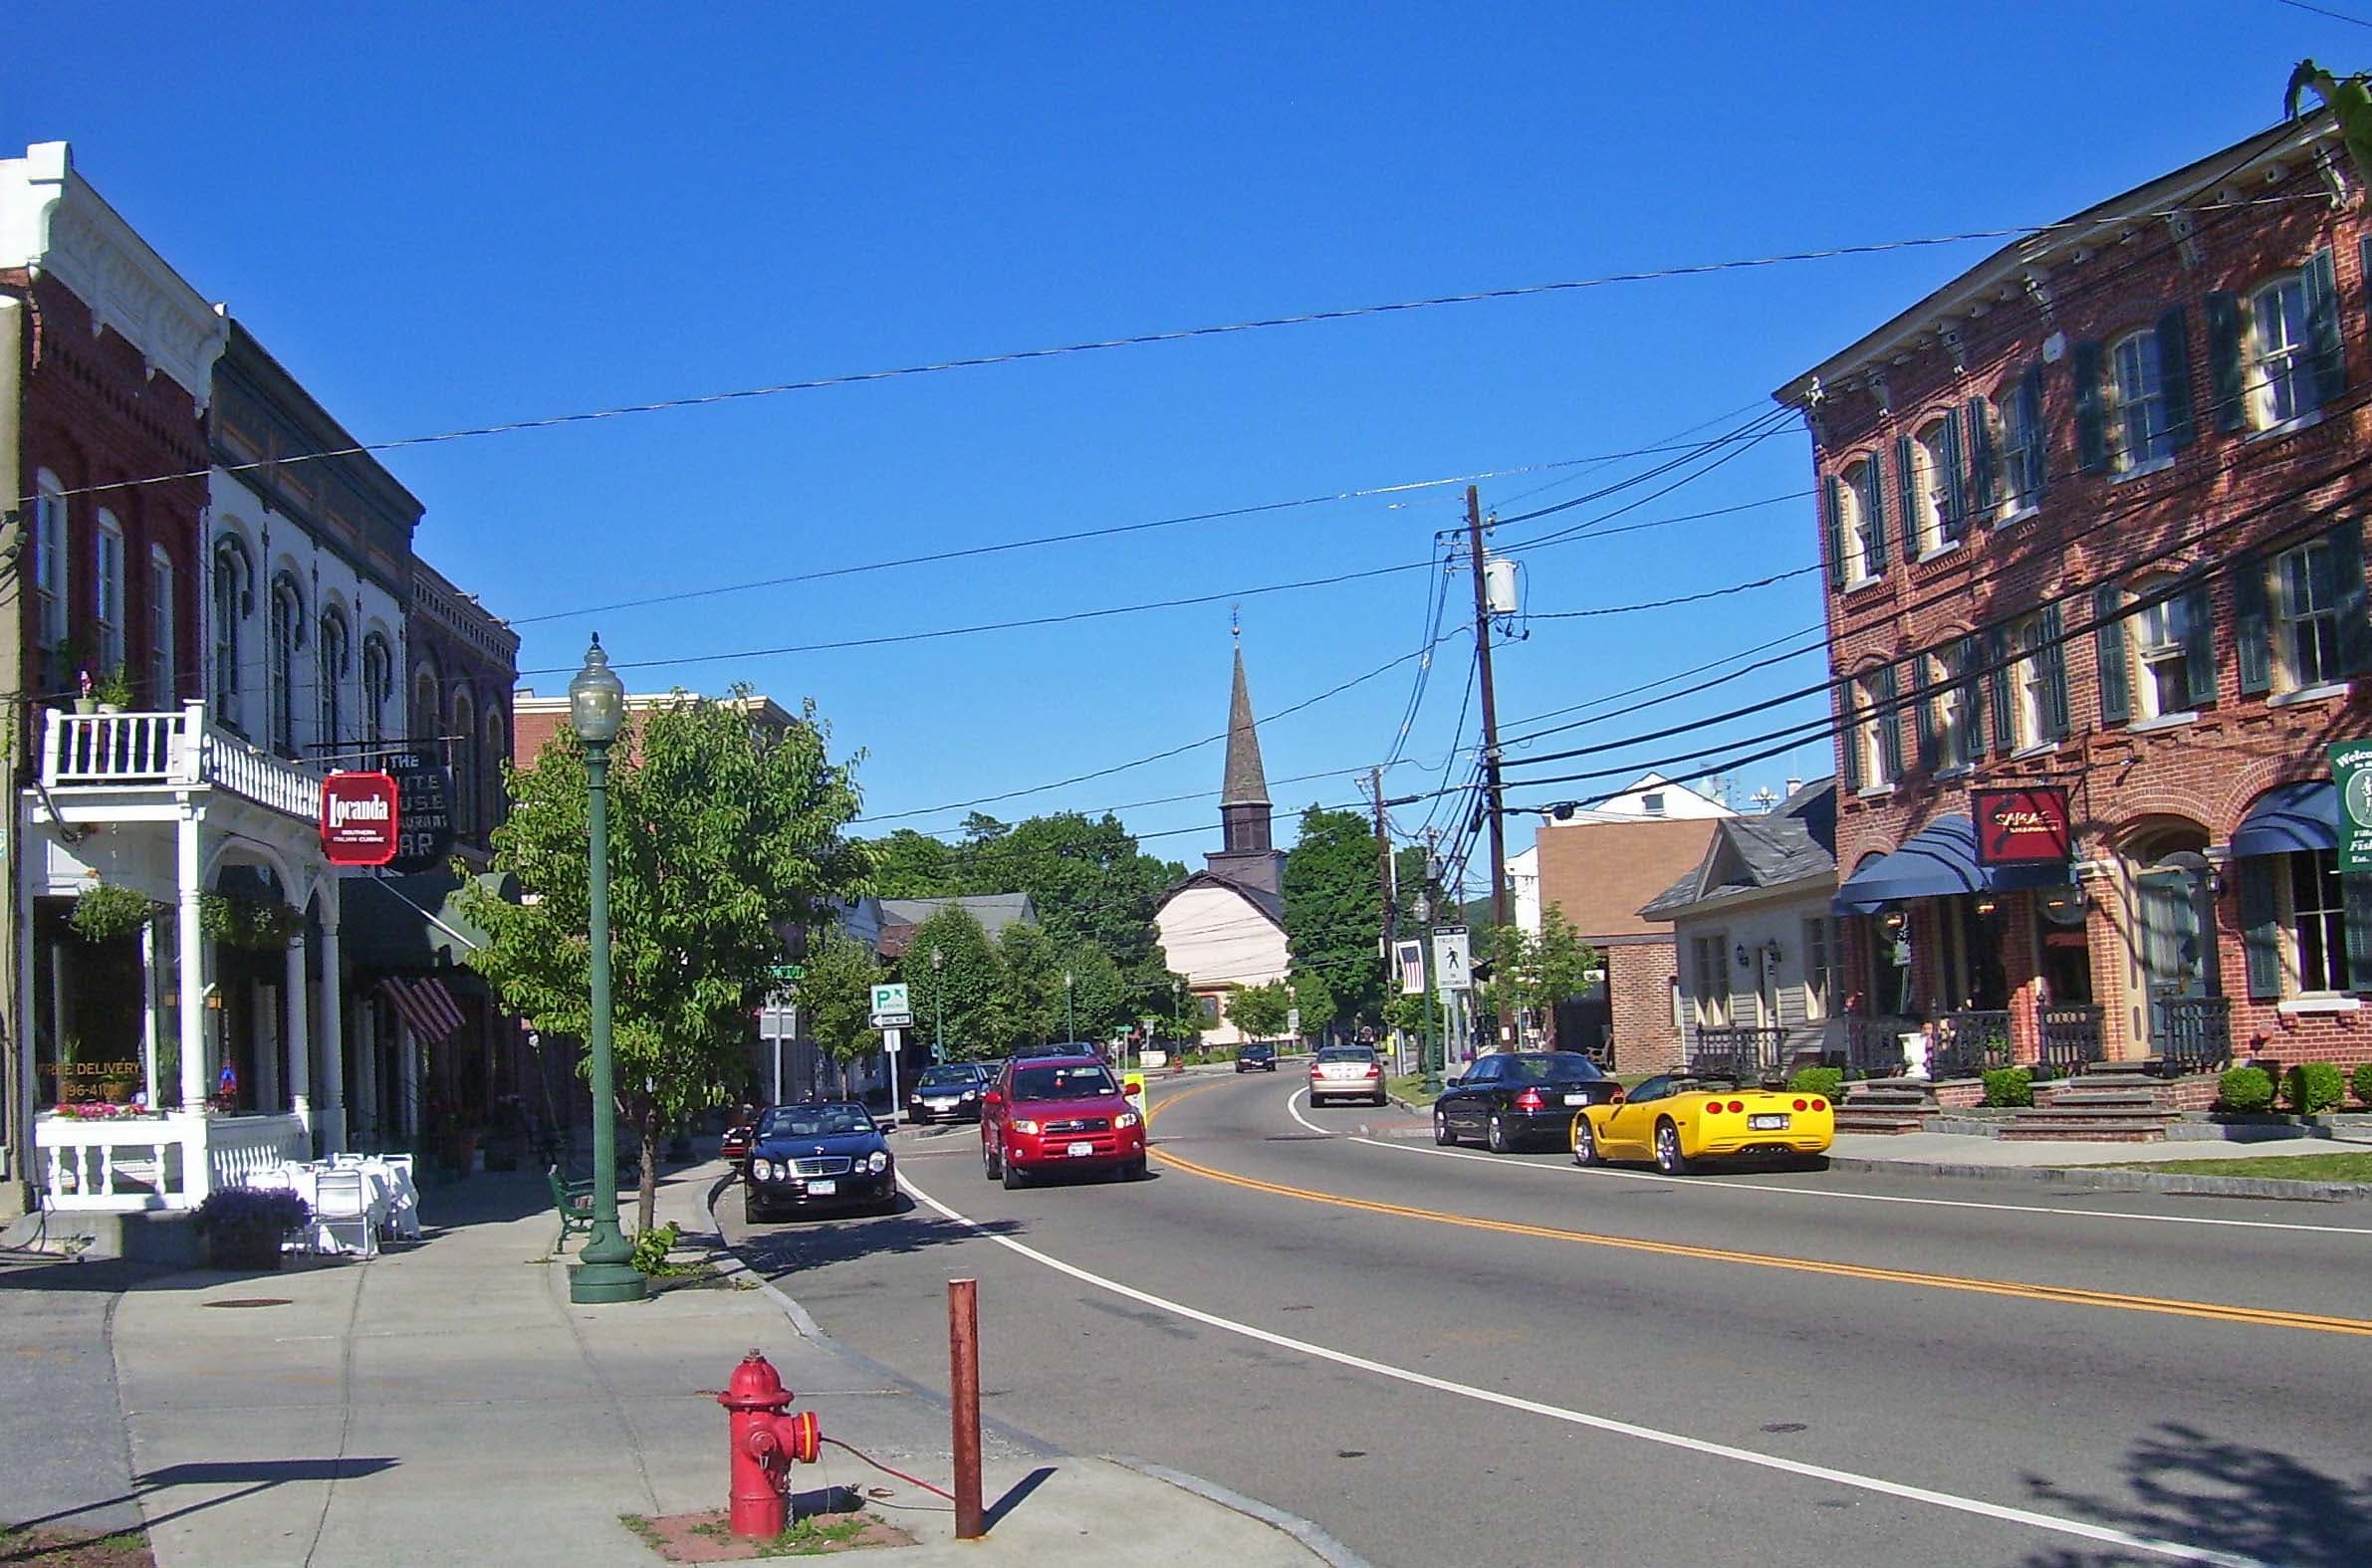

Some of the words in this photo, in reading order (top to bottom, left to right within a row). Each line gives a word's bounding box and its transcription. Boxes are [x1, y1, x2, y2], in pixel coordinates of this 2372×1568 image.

[389, 755, 419, 769] THE
[329, 793, 389, 828] Locanda
[399, 795, 446, 811] USE
[399, 832, 433, 856] AR
[78, 1062, 140, 1076] DELIVERY
